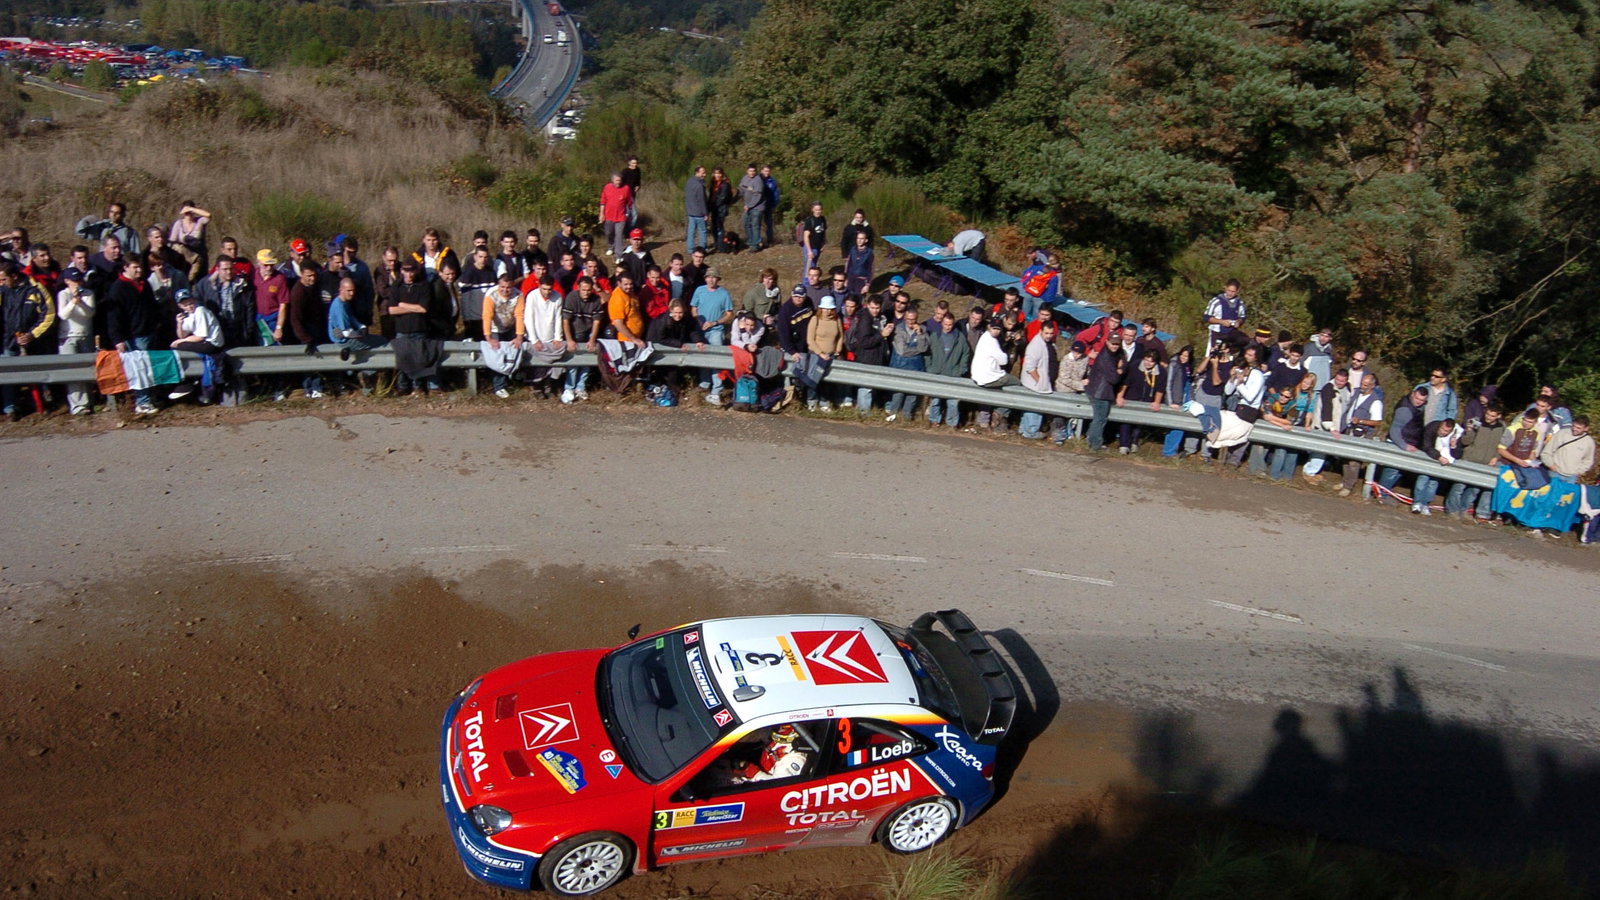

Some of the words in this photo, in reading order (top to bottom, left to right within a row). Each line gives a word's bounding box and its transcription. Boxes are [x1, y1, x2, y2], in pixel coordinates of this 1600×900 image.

[745, 652, 781, 666] 3
[692, 661, 719, 706] MICHELIN
[838, 717, 851, 754] 3
[984, 726, 1005, 734] TOTAL
[464, 710, 490, 783] TOTAL
[601, 751, 614, 760] E
[872, 740, 912, 761] Loeb
[934, 724, 983, 771] Xsara
[780, 768, 911, 812] CITROËN
[656, 812, 668, 829] 3
[785, 810, 865, 826] TOTAL
[466, 844, 521, 869] MICHELIN
[682, 840, 743, 852] MICHELIN
